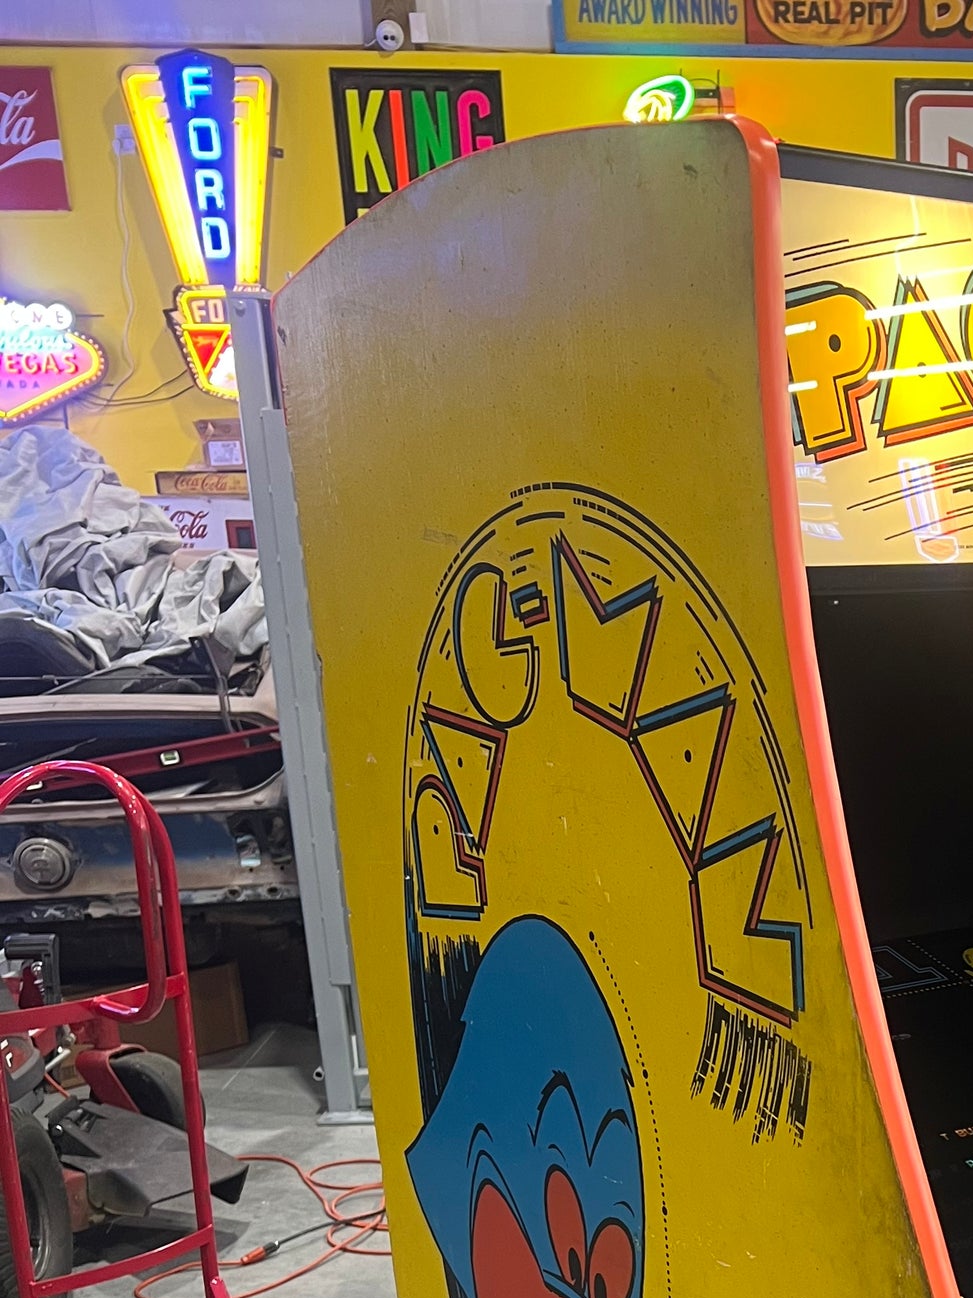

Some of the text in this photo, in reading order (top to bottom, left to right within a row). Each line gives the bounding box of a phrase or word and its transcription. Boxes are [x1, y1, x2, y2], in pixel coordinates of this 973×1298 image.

[577, 0, 738, 26] AWARD WINNING
[773, 1, 893, 26] REAL PIT
[181, 66, 231, 259] FORD
[345, 88, 494, 193] KING
[0, 352, 79, 374] EGAS
[412, 527, 805, 1029] PAC-MAN
